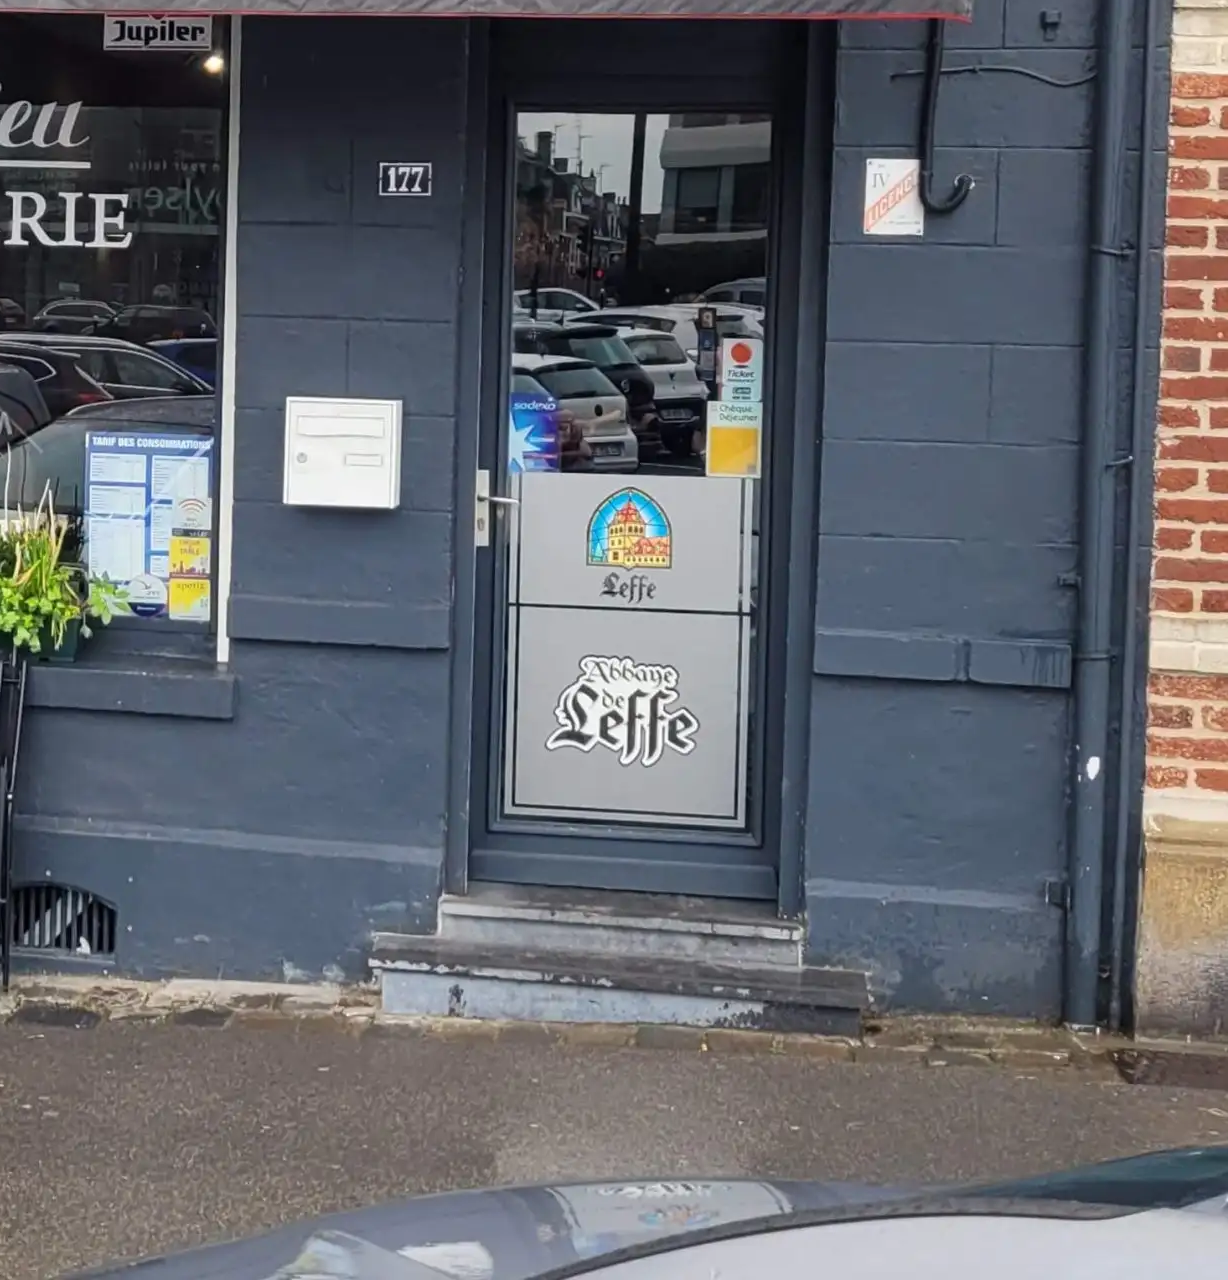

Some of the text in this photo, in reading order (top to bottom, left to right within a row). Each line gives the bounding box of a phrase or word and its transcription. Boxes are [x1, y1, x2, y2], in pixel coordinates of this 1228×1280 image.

[387, 166, 424, 192] 177
[727, 369, 755, 379] Ticket
[514, 401, 557, 411] sodexo
[92, 436, 116, 447] TARIF
[118, 437, 135, 448] DES
[599, 572, 656, 603] Leffe
[585, 660, 674, 686] Abbaye
[601, 687, 625, 710] de
[552, 683, 694, 760] Leffe
